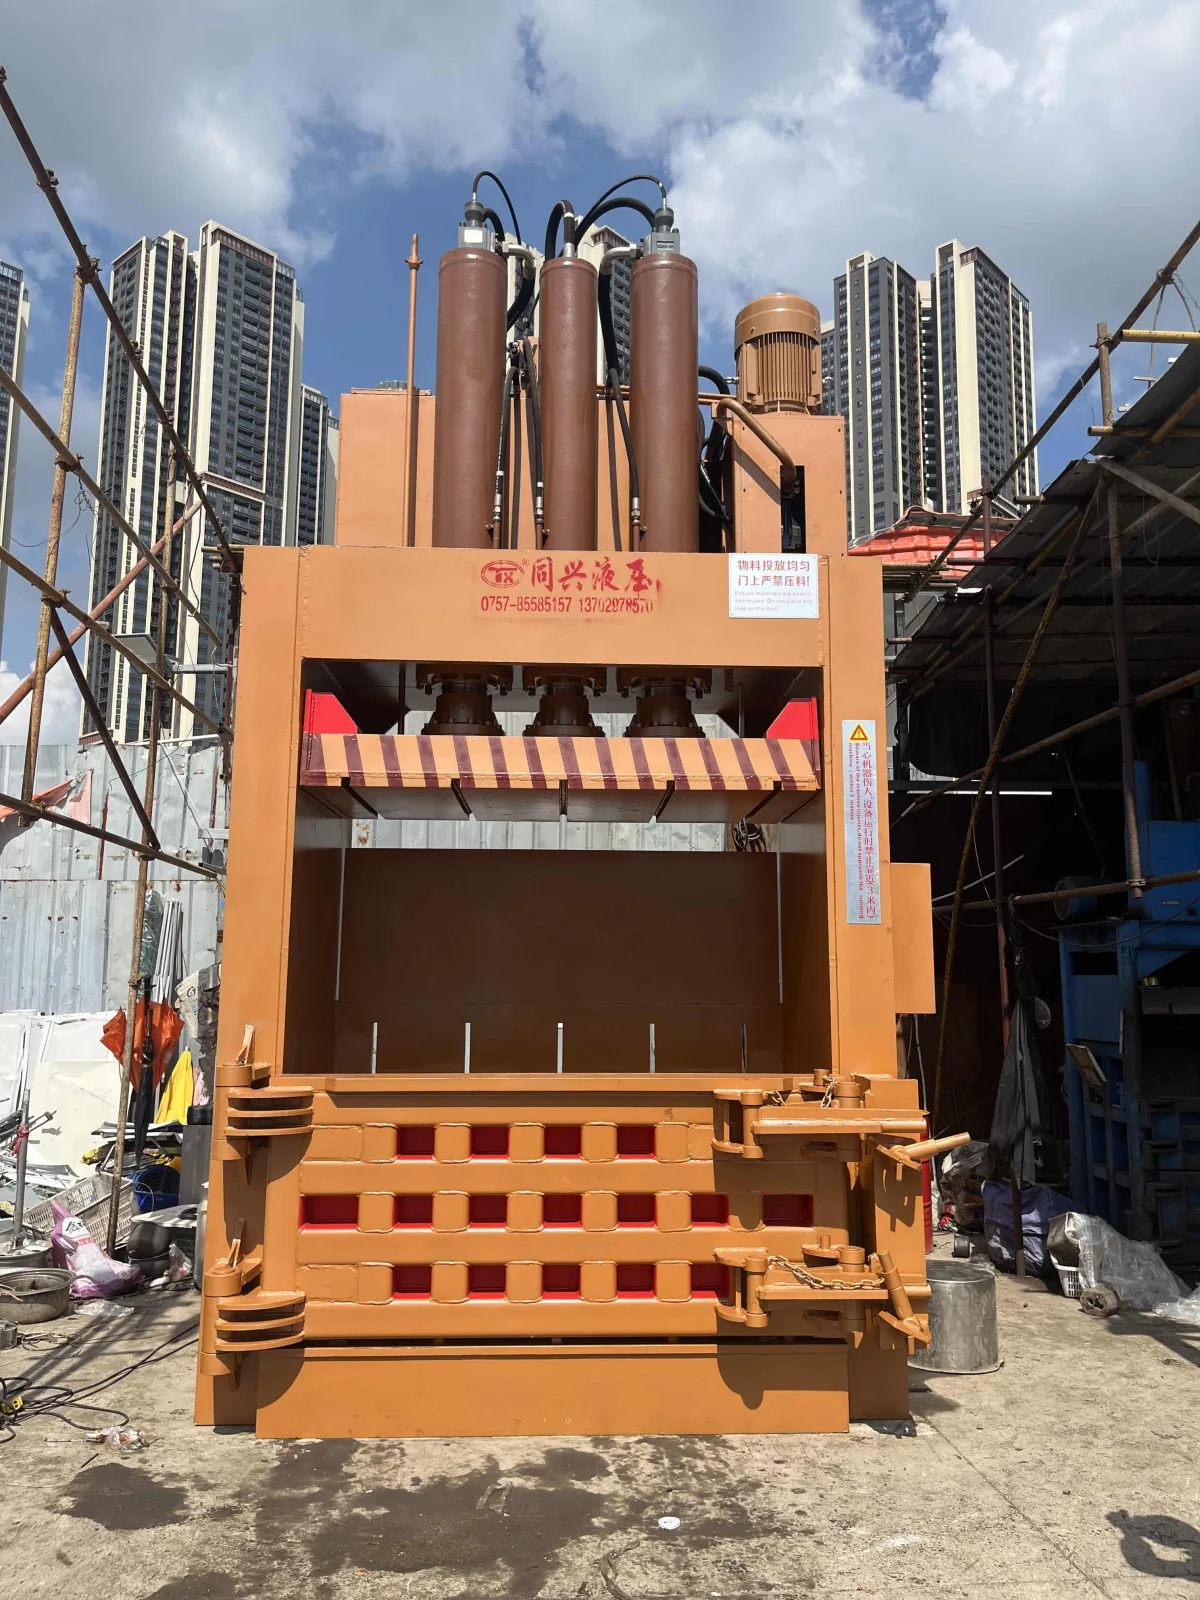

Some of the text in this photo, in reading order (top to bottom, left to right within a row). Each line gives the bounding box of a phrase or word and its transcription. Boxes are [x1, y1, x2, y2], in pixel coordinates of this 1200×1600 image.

[737, 560, 810, 571] 物料投放均匀
[480, 595, 653, 613] 0757-85585157 13702978570
